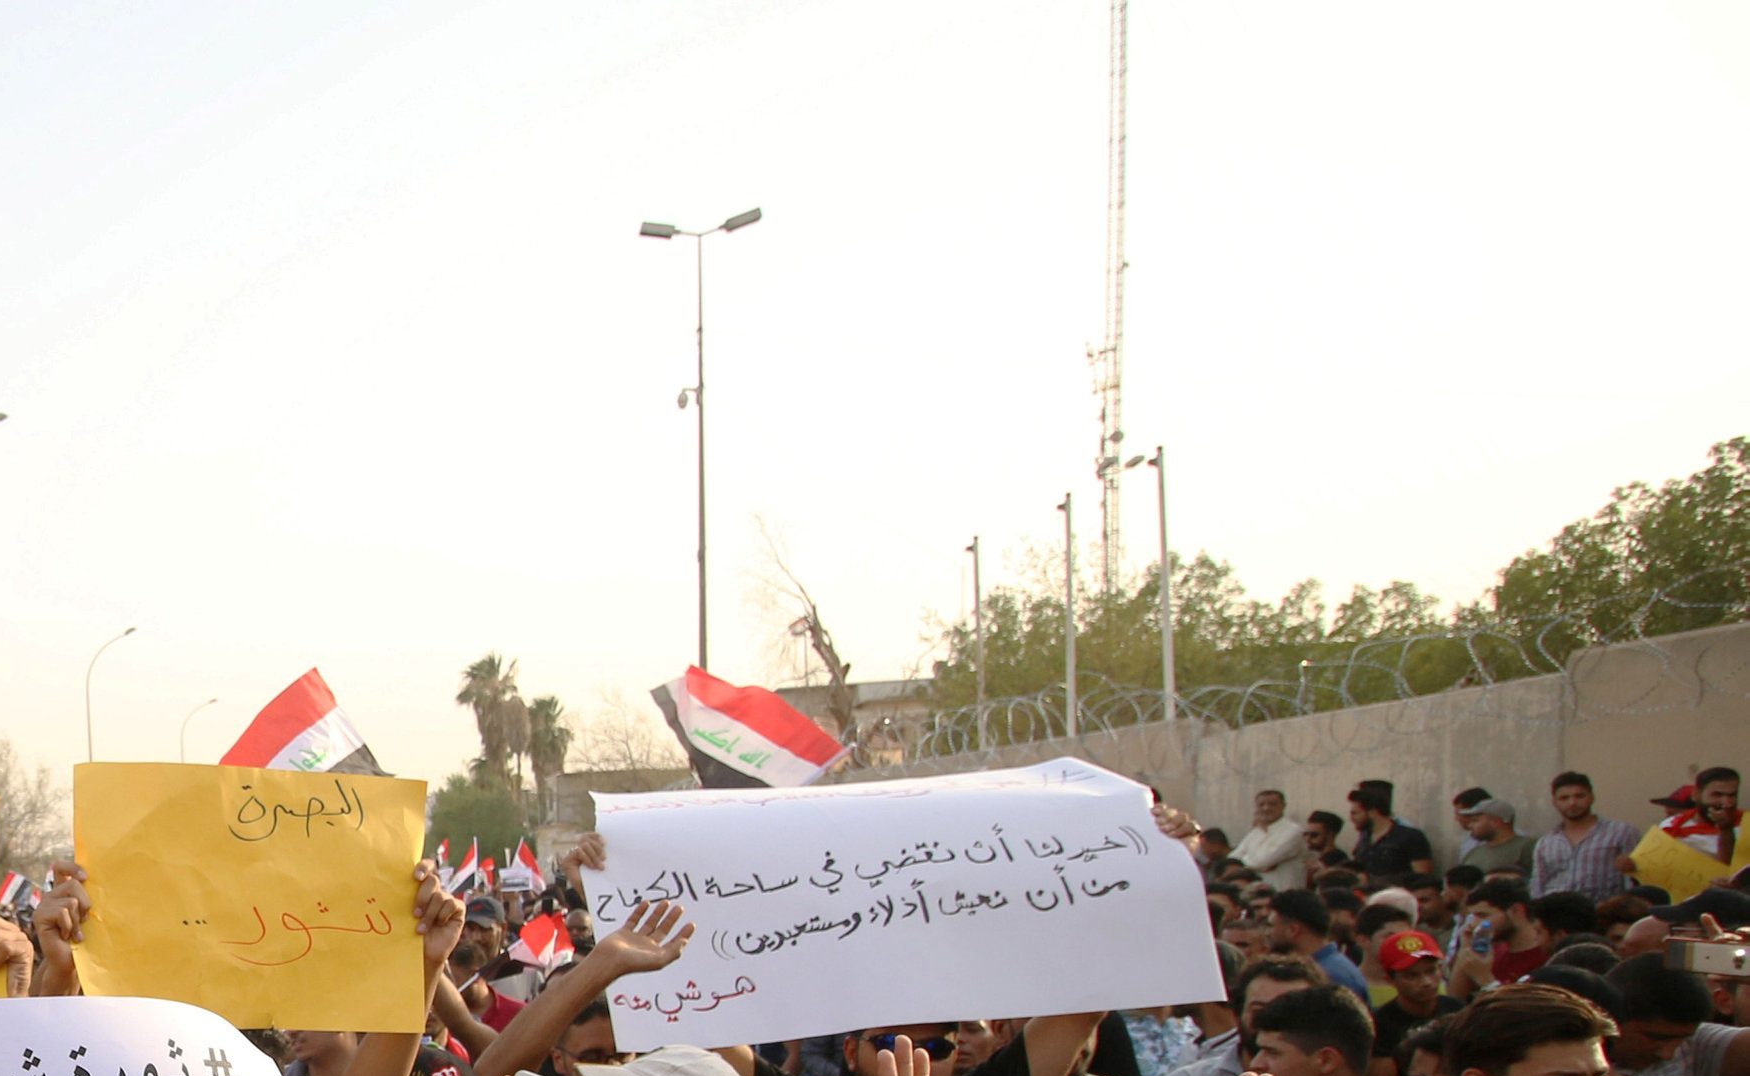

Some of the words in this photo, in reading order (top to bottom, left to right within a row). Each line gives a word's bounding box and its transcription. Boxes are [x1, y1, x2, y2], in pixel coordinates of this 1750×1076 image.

[229, 779, 364, 842] البصرة
[855, 841, 955, 888] نقضي
[964, 823, 1014, 863] أن
[705, 873, 799, 898] ساحة
[809, 851, 844, 894] في
[1025, 864, 1075, 911] أن
[1081, 878, 1130, 897] من
[597, 870, 699, 922] الكفاح
[938, 890, 1008, 916] نعيش
